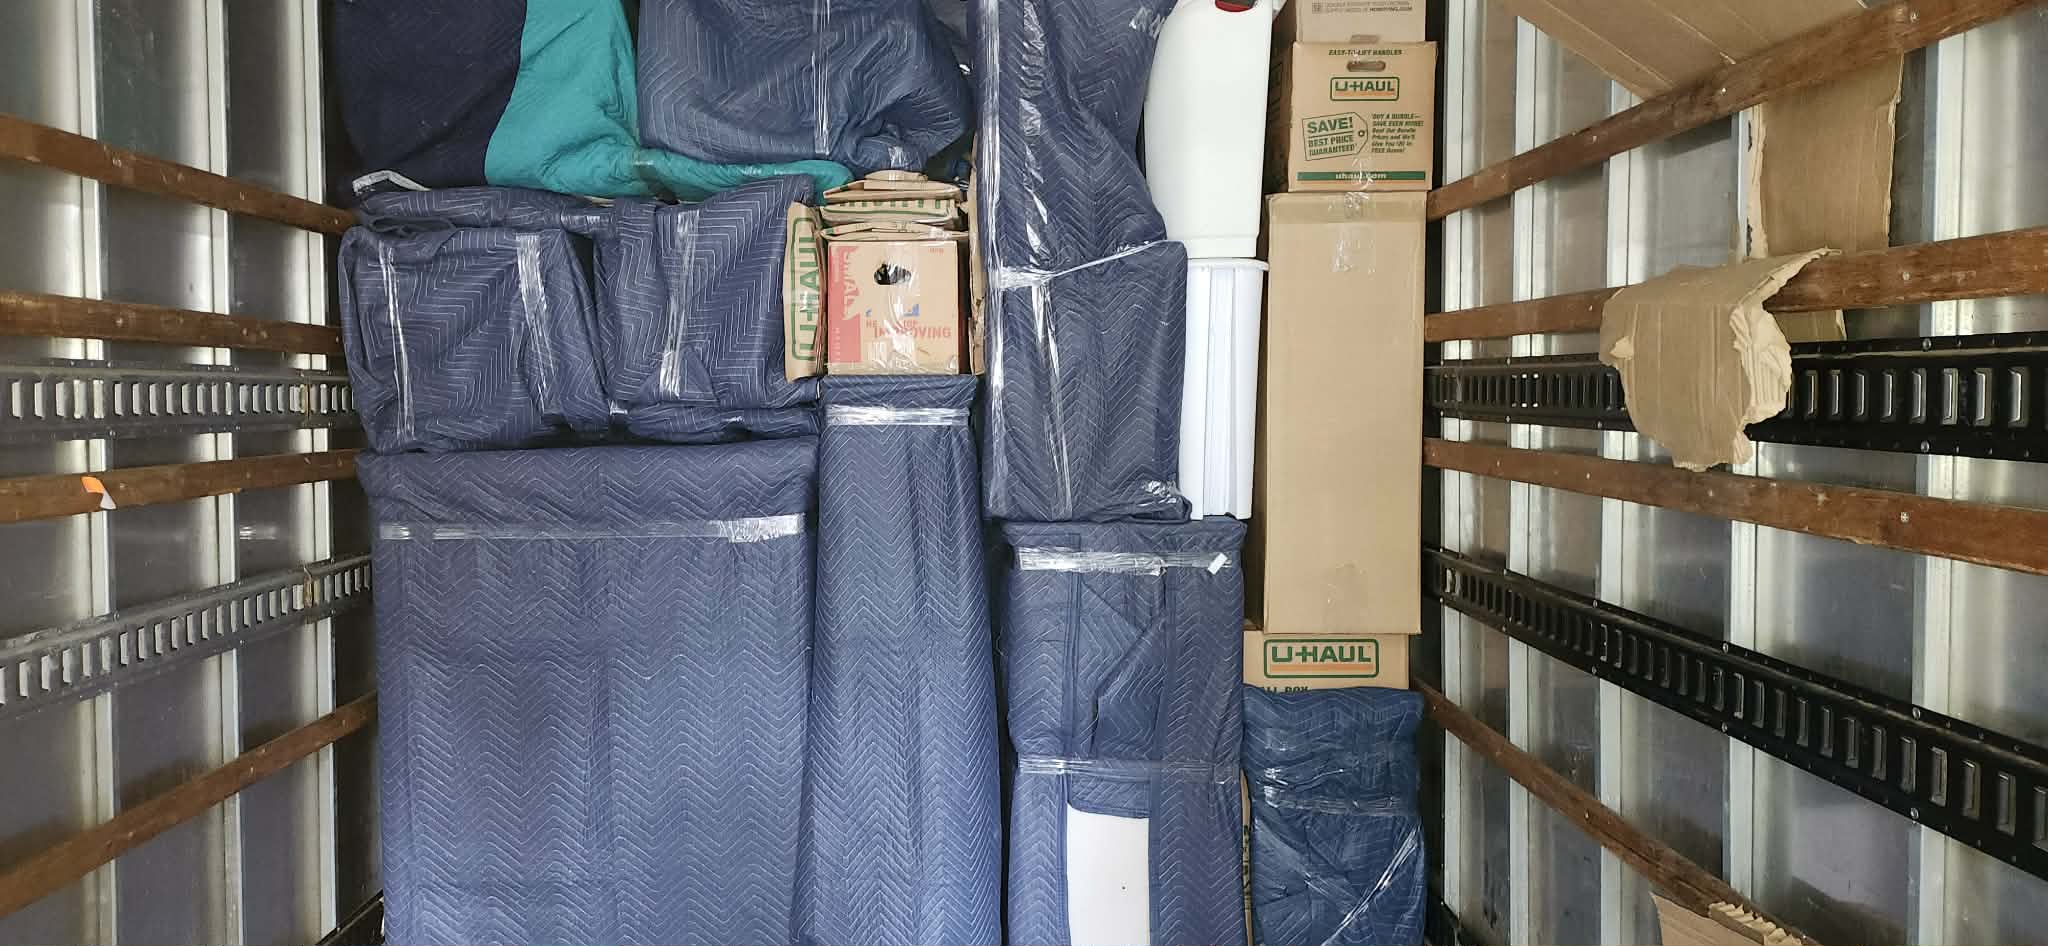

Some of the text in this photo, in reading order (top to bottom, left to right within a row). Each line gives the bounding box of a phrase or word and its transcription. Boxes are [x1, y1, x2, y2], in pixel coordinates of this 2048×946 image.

[1335, 80, 1395, 92] U-HAUL
[1307, 116, 1353, 134] SAVE!
[1308, 135, 1353, 148] BEST PRICE
[1271, 645, 1372, 663] U-HAUL
